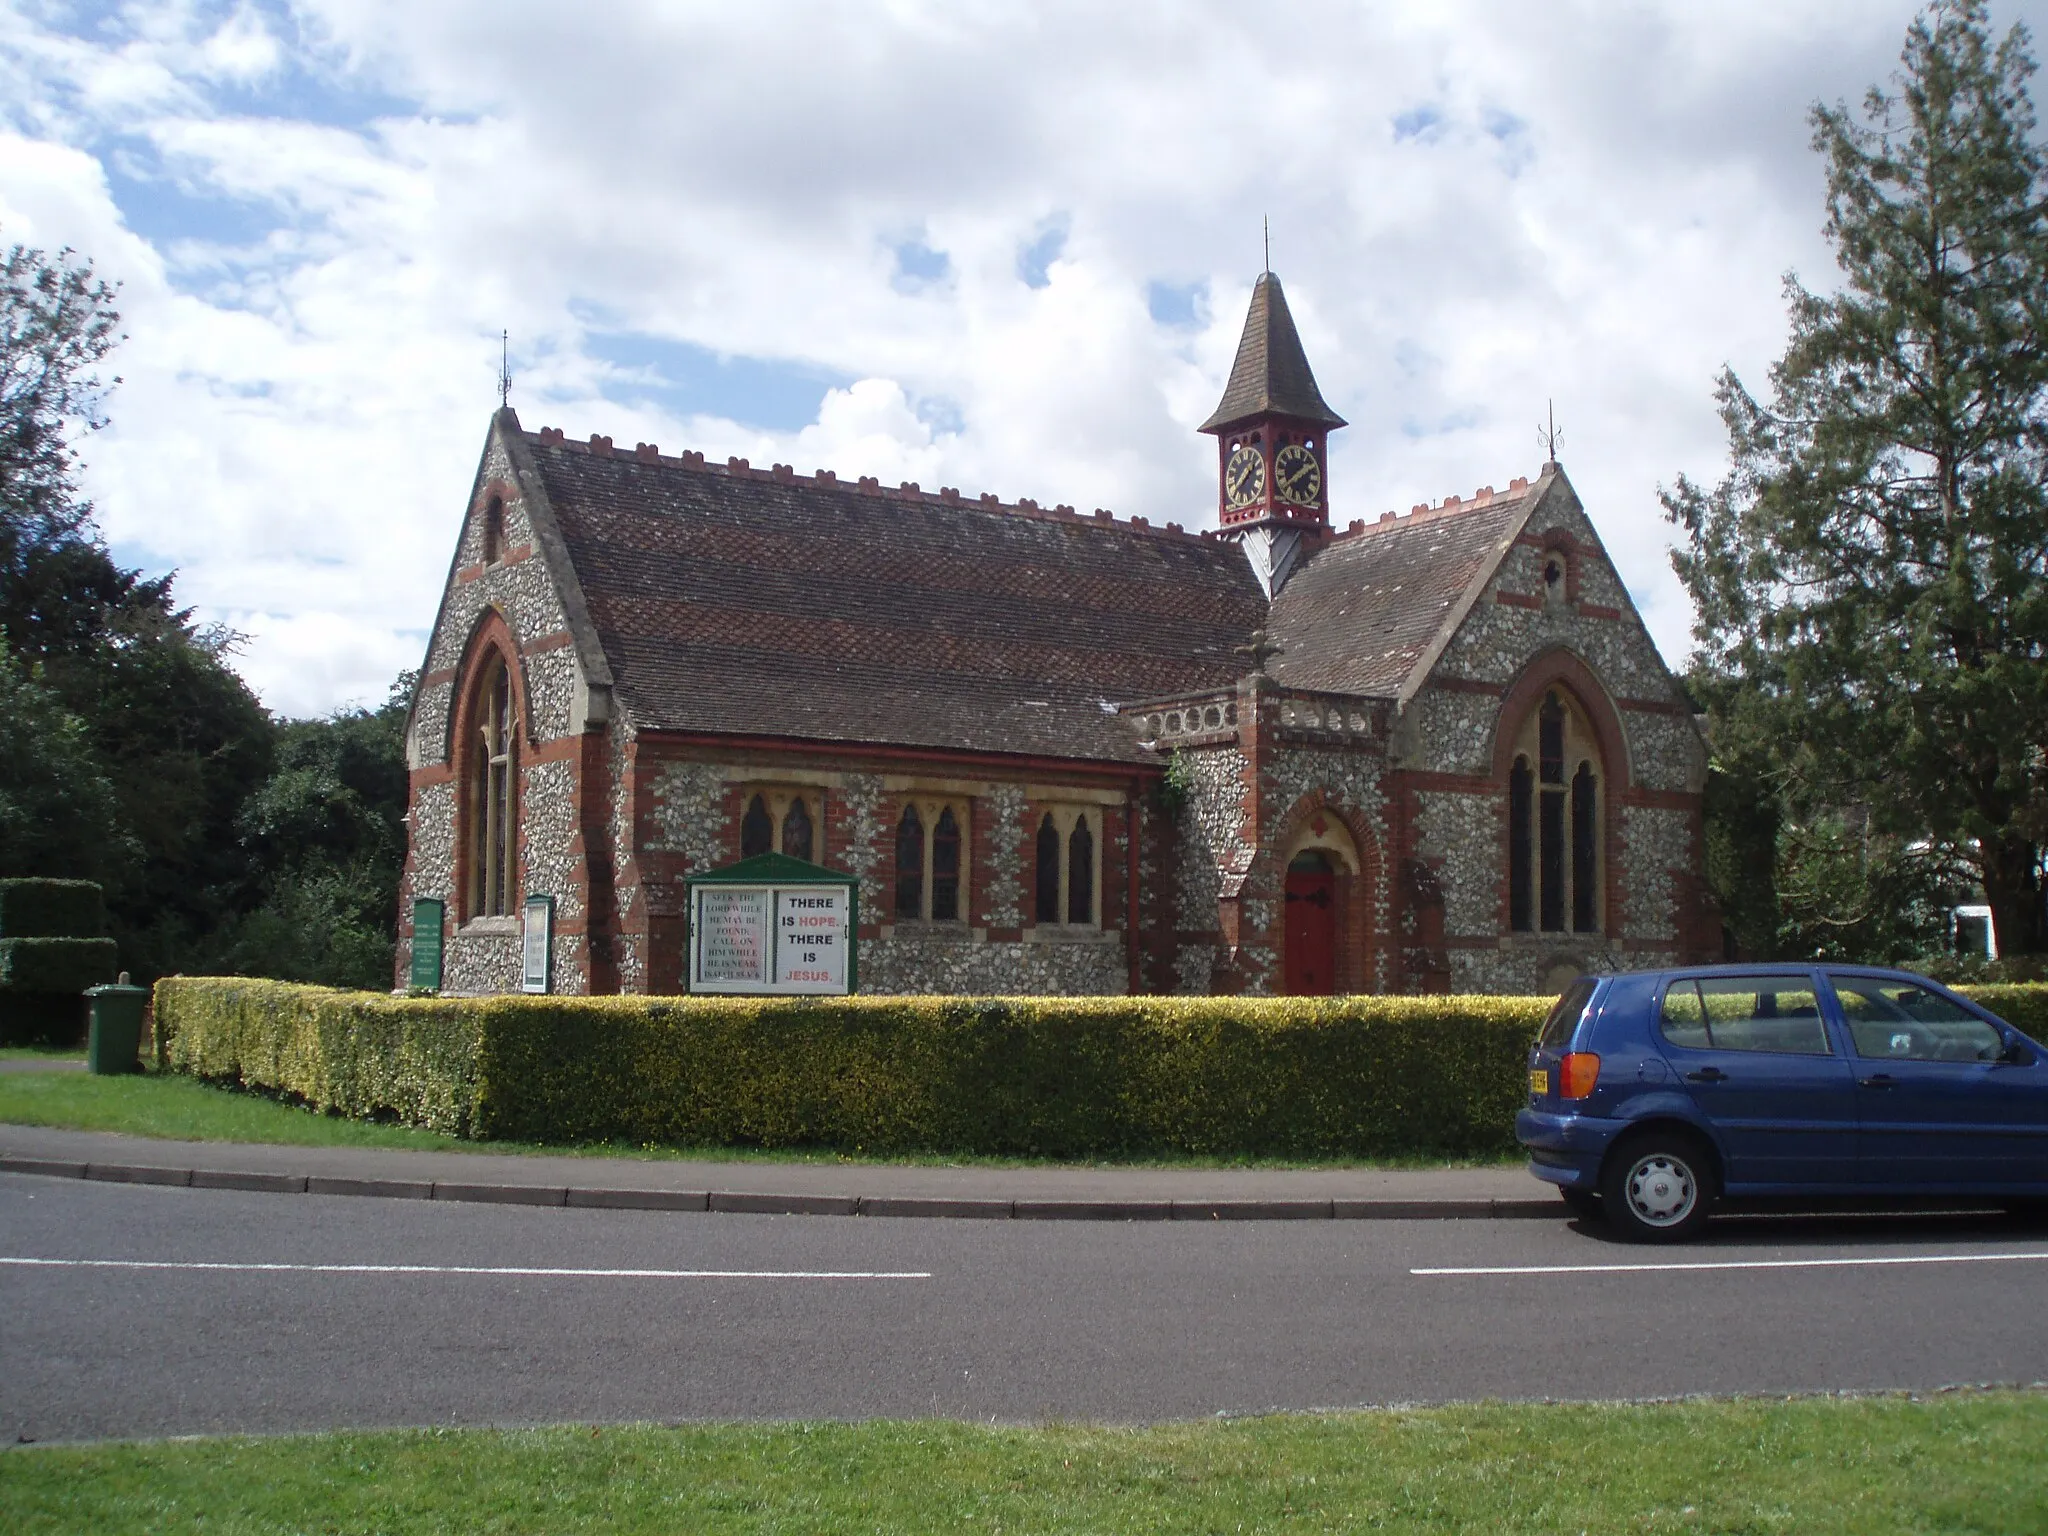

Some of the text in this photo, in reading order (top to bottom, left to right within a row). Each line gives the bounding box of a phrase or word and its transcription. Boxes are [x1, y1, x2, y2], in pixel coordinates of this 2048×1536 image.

[789, 898, 833, 908] THERE
[782, 916, 839, 927] IS HOPE.
[713, 937, 752, 946] CALL ON
[788, 935, 833, 944] THERE
[727, 949, 757, 957] WHILE
[803, 953, 816, 962] IS
[785, 970, 832, 981] JESUS.
